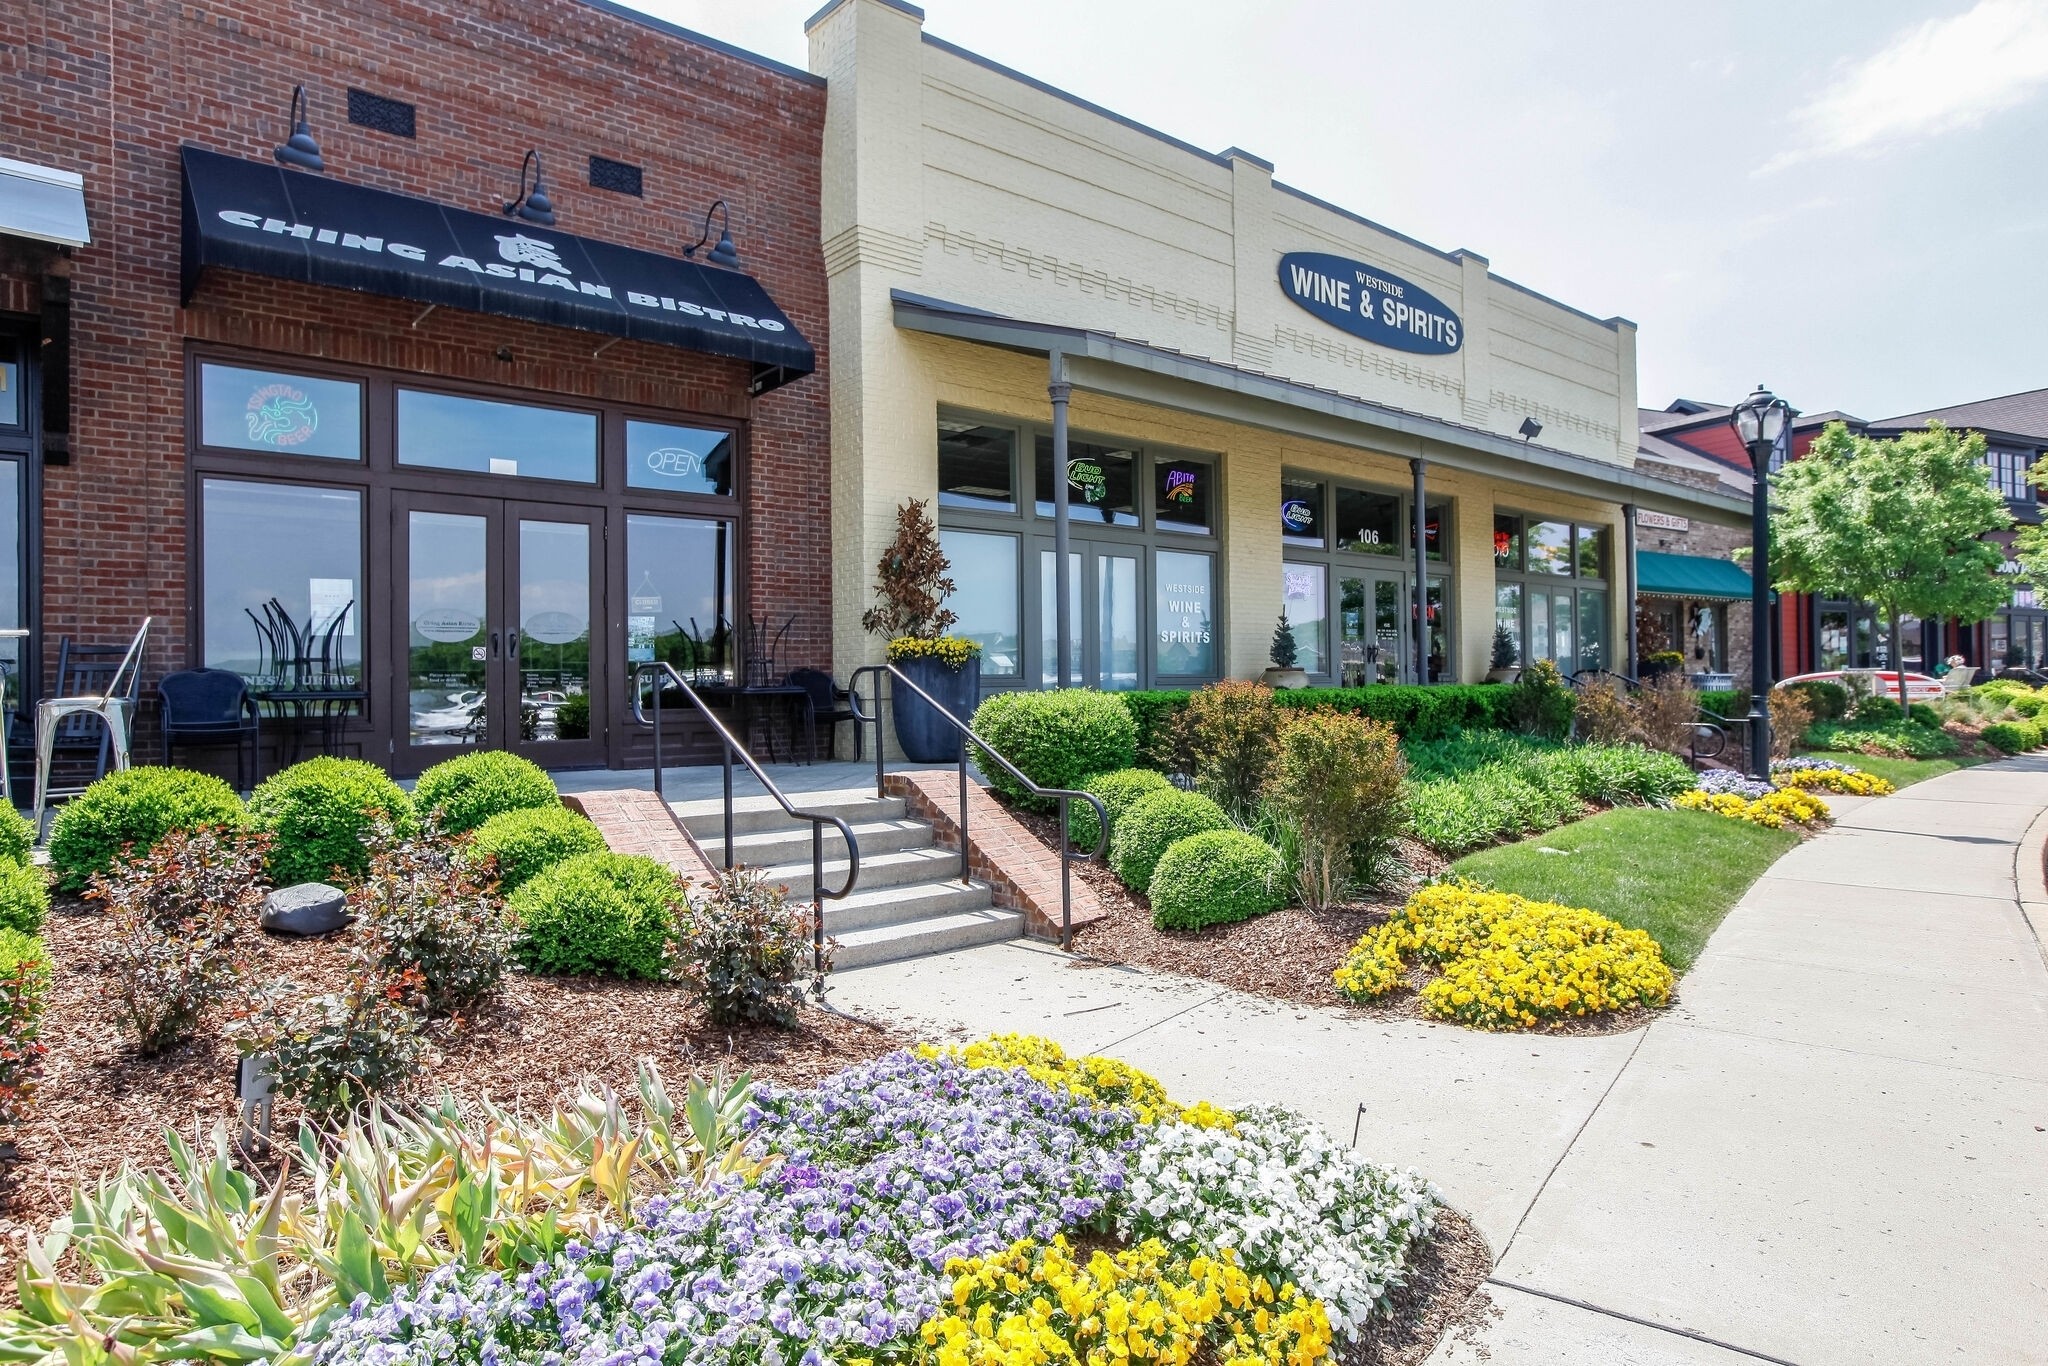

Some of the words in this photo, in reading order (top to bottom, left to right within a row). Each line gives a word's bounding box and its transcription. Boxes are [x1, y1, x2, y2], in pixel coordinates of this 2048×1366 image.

[218, 210, 427, 262] CHING
[438, 255, 612, 299] ASIAN
[627, 291, 785, 332] BISTRO
[1355, 270, 1404, 299] WESTSIDE
[1290, 263, 1351, 312] WINE
[1359, 289, 1375, 320] &
[1382, 297, 1458, 347] SPIRITS
[247, 384, 303, 410] TSINGTAO
[278, 425, 314, 446] BEER
[648, 451, 702, 473] OPEN
[1074, 462, 1102, 475] BUD
[1069, 471, 1106, 485] LIGHT
[1637, 512, 1665, 526] FLOWERS
[1672, 517, 1688, 529] GIFTS
[1358, 528, 1379, 545] 106
[1165, 583, 1205, 594] WESTSIDE
[1168, 600, 1201, 613] WINE
[1181, 616, 1190, 628] &
[1161, 630, 1210, 644] SPIRITS
